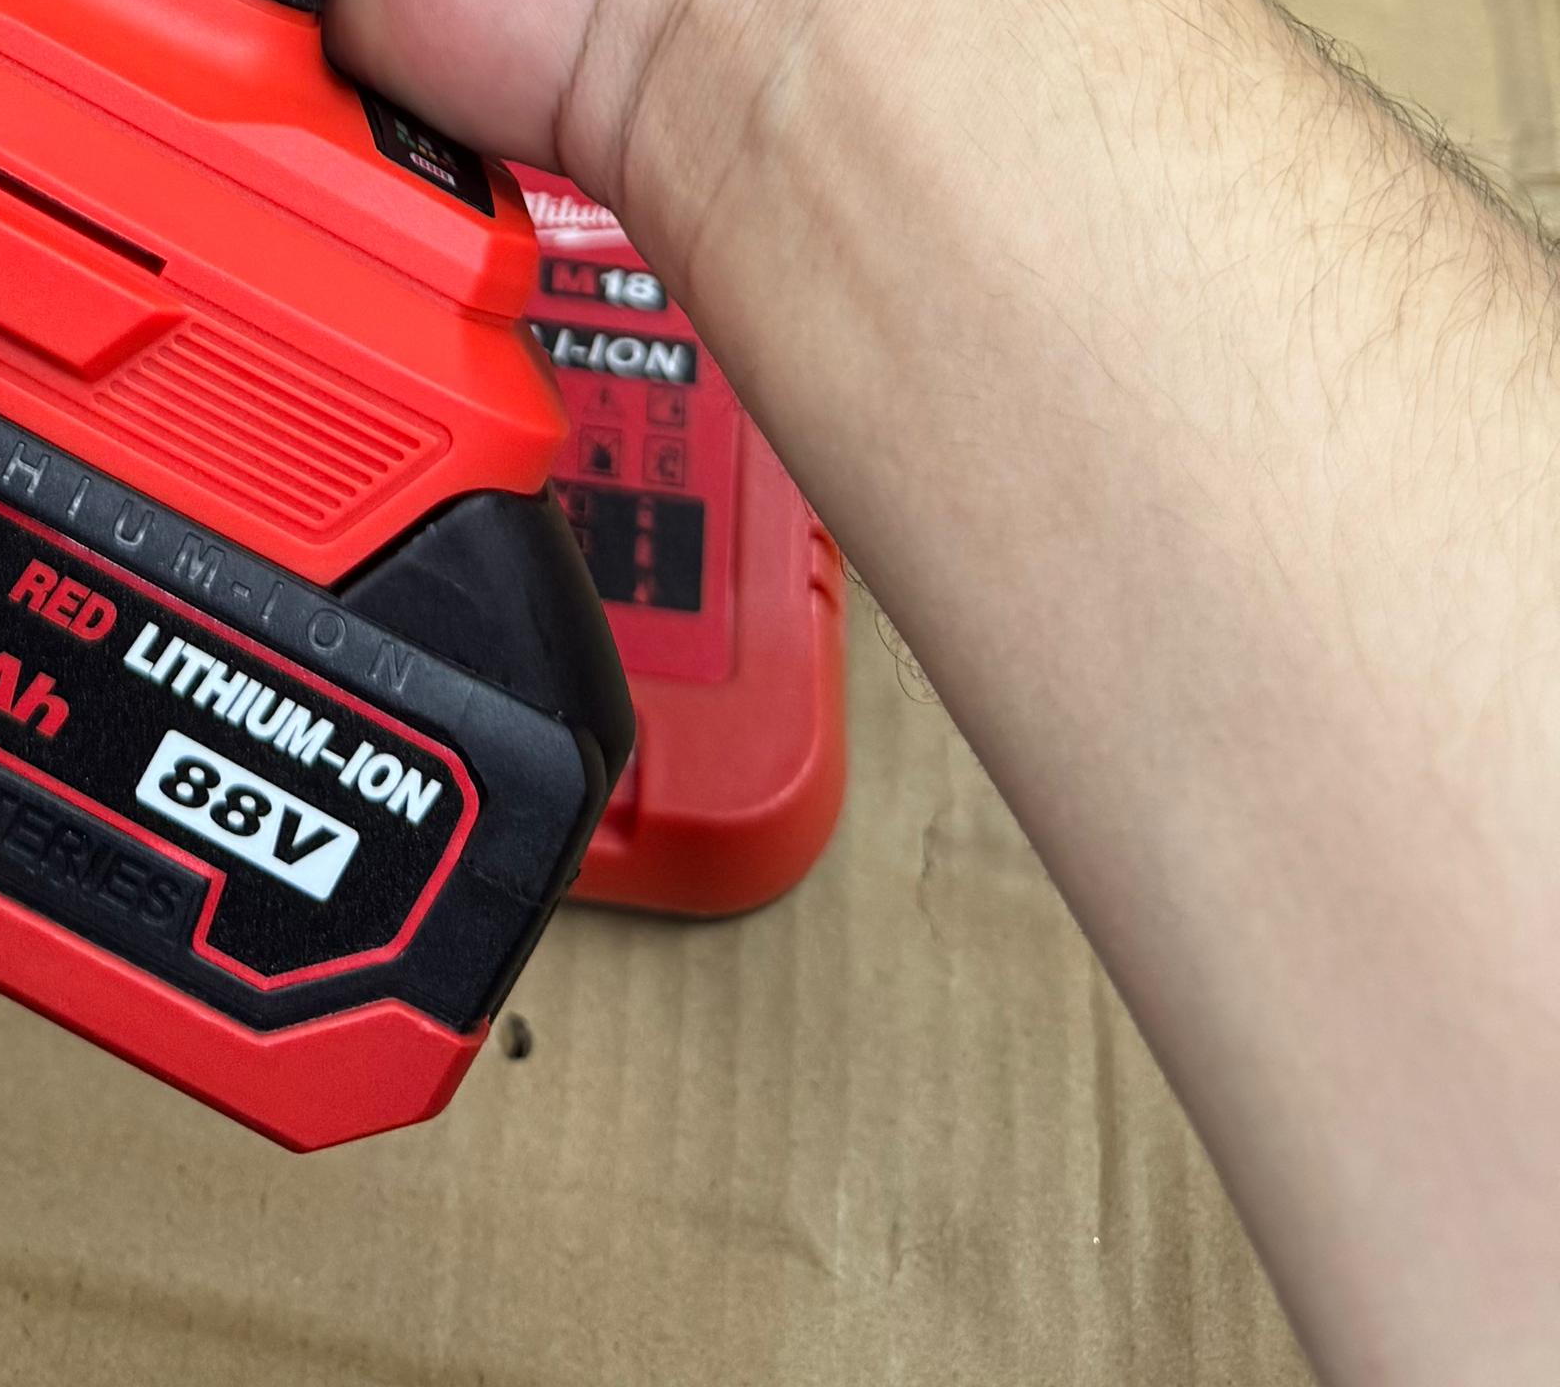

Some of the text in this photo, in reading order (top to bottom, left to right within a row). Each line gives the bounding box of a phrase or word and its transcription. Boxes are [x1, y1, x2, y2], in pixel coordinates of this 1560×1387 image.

[551, 261, 666, 311] M18
[8, 558, 443, 826] RED LITHIUM-ION
[158, 754, 340, 866] 88V
